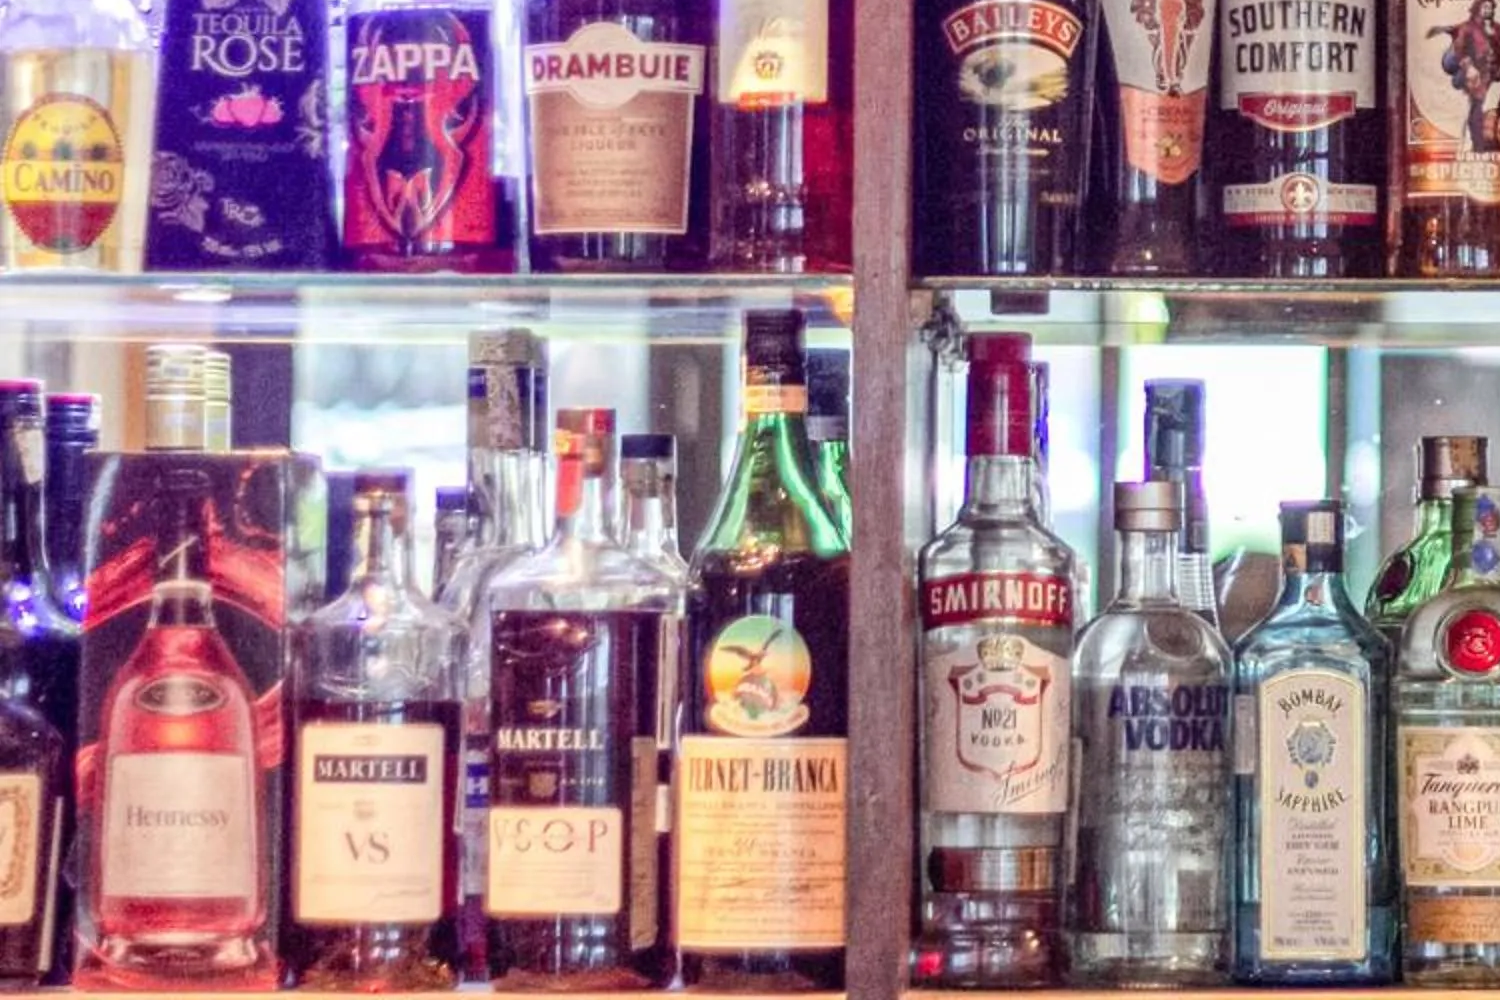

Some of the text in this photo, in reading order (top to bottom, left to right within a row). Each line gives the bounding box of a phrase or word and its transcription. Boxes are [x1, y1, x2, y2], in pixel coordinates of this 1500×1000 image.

[191, 13, 303, 35] TEQUILA
[950, 2, 1074, 44] BAILEYS
[1228, 0, 1366, 38] SOUTHERN
[191, 34, 305, 77] ROSE
[351, 43, 481, 85] ZAPPA
[532, 52, 692, 82] DRAMBUIE
[1235, 42, 1359, 74] COMFORT
[1262, 97, 1330, 119] Original
[962, 127, 1064, 143] ORIGINAL
[930, 578, 1068, 615] SMIRNOFF
[1108, 685, 1230, 718] ABSOLUT
[1278, 688, 1344, 716] BOMBAY
[498, 729, 605, 750] MARTELL
[970, 733, 1026, 747] VODKA
[1125, 719, 1225, 752] VODKA
[317, 758, 422, 780] MARTELL
[1277, 787, 1346, 814] SAPPHIRE
[126, 804, 231, 831] Hennessy
[1447, 815, 1487, 829] LIME
[345, 832, 391, 864] VS
